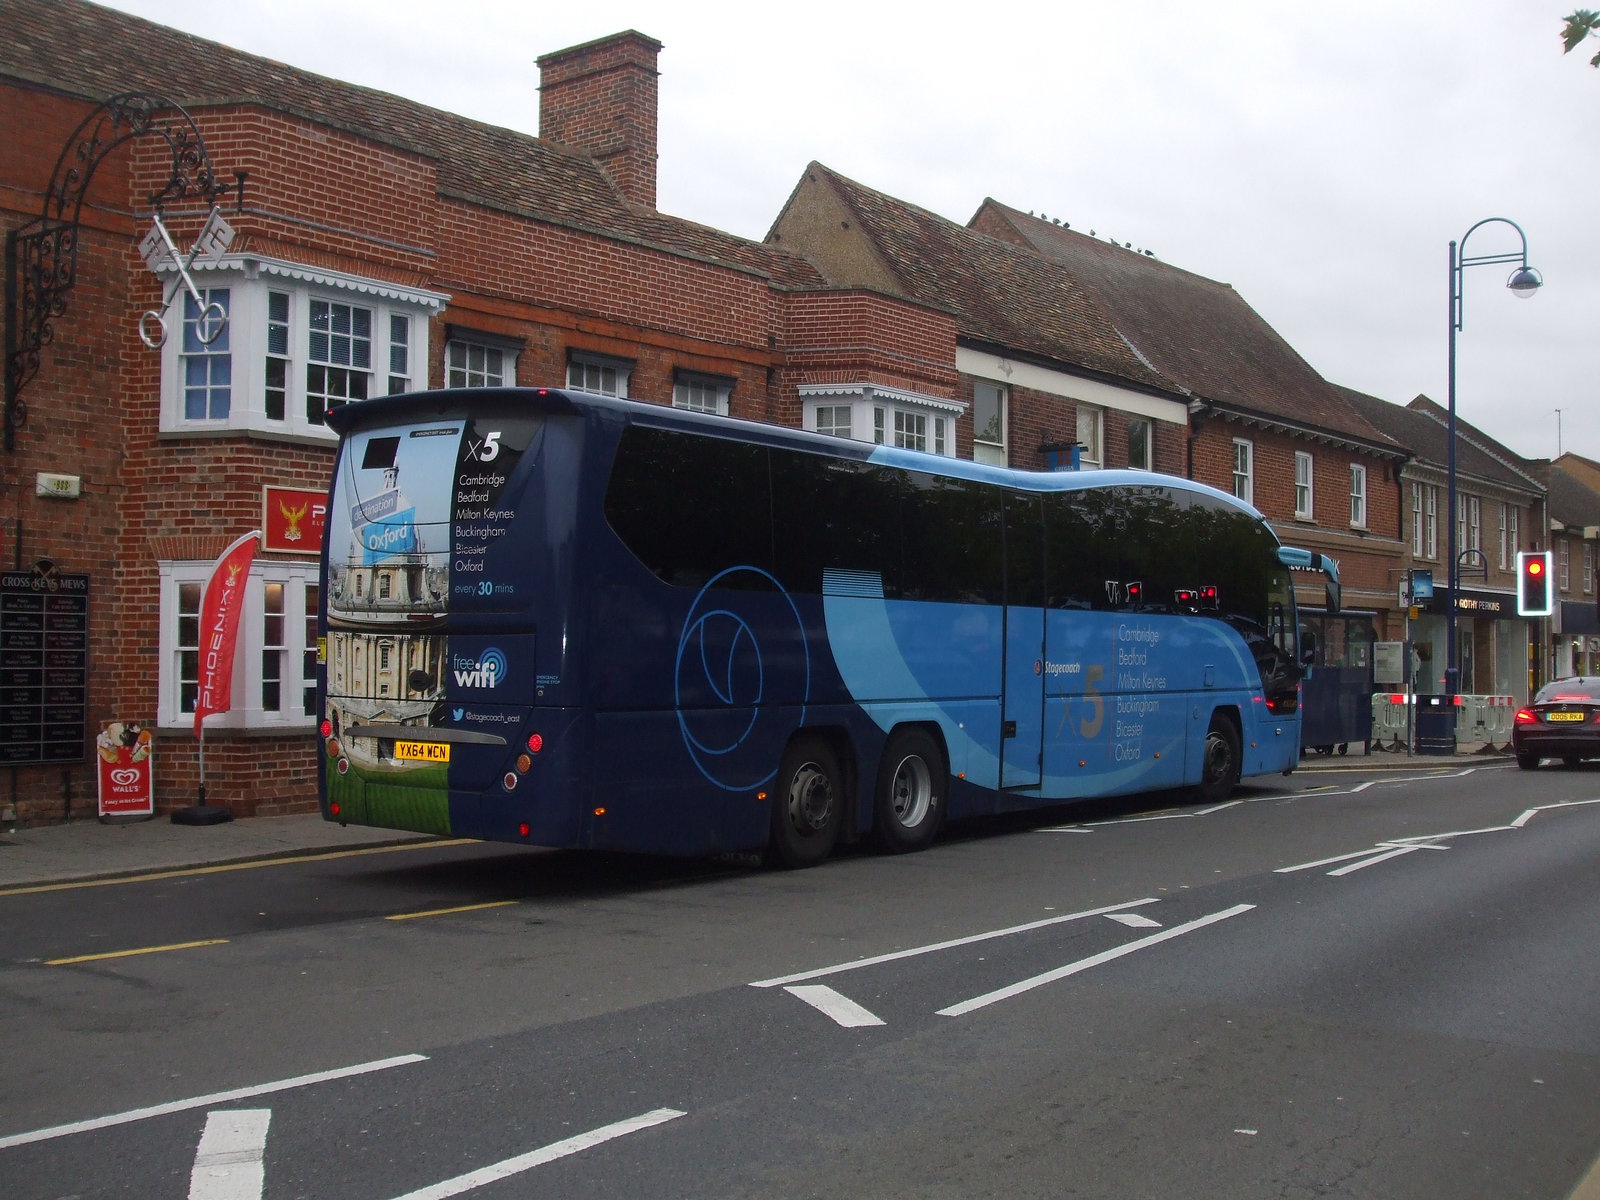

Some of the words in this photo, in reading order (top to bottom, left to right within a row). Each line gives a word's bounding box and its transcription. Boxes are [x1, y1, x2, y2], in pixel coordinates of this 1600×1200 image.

[459, 474, 505, 488] Cambridge
[458, 491, 489, 503] Bedford
[354, 496, 394, 522] destination
[456, 509, 481, 520] Milton
[484, 508, 514, 523] Keynes
[368, 523, 408, 551] Oxford
[456, 526, 506, 540] Buckingham
[455, 560, 484, 572] Oxford
[2, 576, 30, 588] CROSS
[34, 578, 57, 588] KEYS
[60, 579, 86, 590] MEWS
[455, 584, 477, 596] every
[478, 582, 492, 596] 30
[494, 583, 514, 594] mins
[1478, 600, 1500, 611] PERKINS
[1118, 624, 1160, 648] Cambridge
[202, 589, 230, 709] PHOENIX
[1118, 648, 1148, 666] Bedford
[454, 653, 474, 670] free
[1044, 660, 1081, 677] Stagecoach
[454, 662, 496, 689] wifi
[1118, 672, 1140, 689] Milton
[1142, 674, 1167, 690] Keynes
[1116, 694, 1160, 718] Buckingham
[465, 710, 521, 724] @stagecoach_east
[1116, 721, 1144, 738] Bicester
[400, 743, 424, 757] YX64
[427, 745, 446, 758] WCN
[1115, 744, 1141, 762] Oxford
